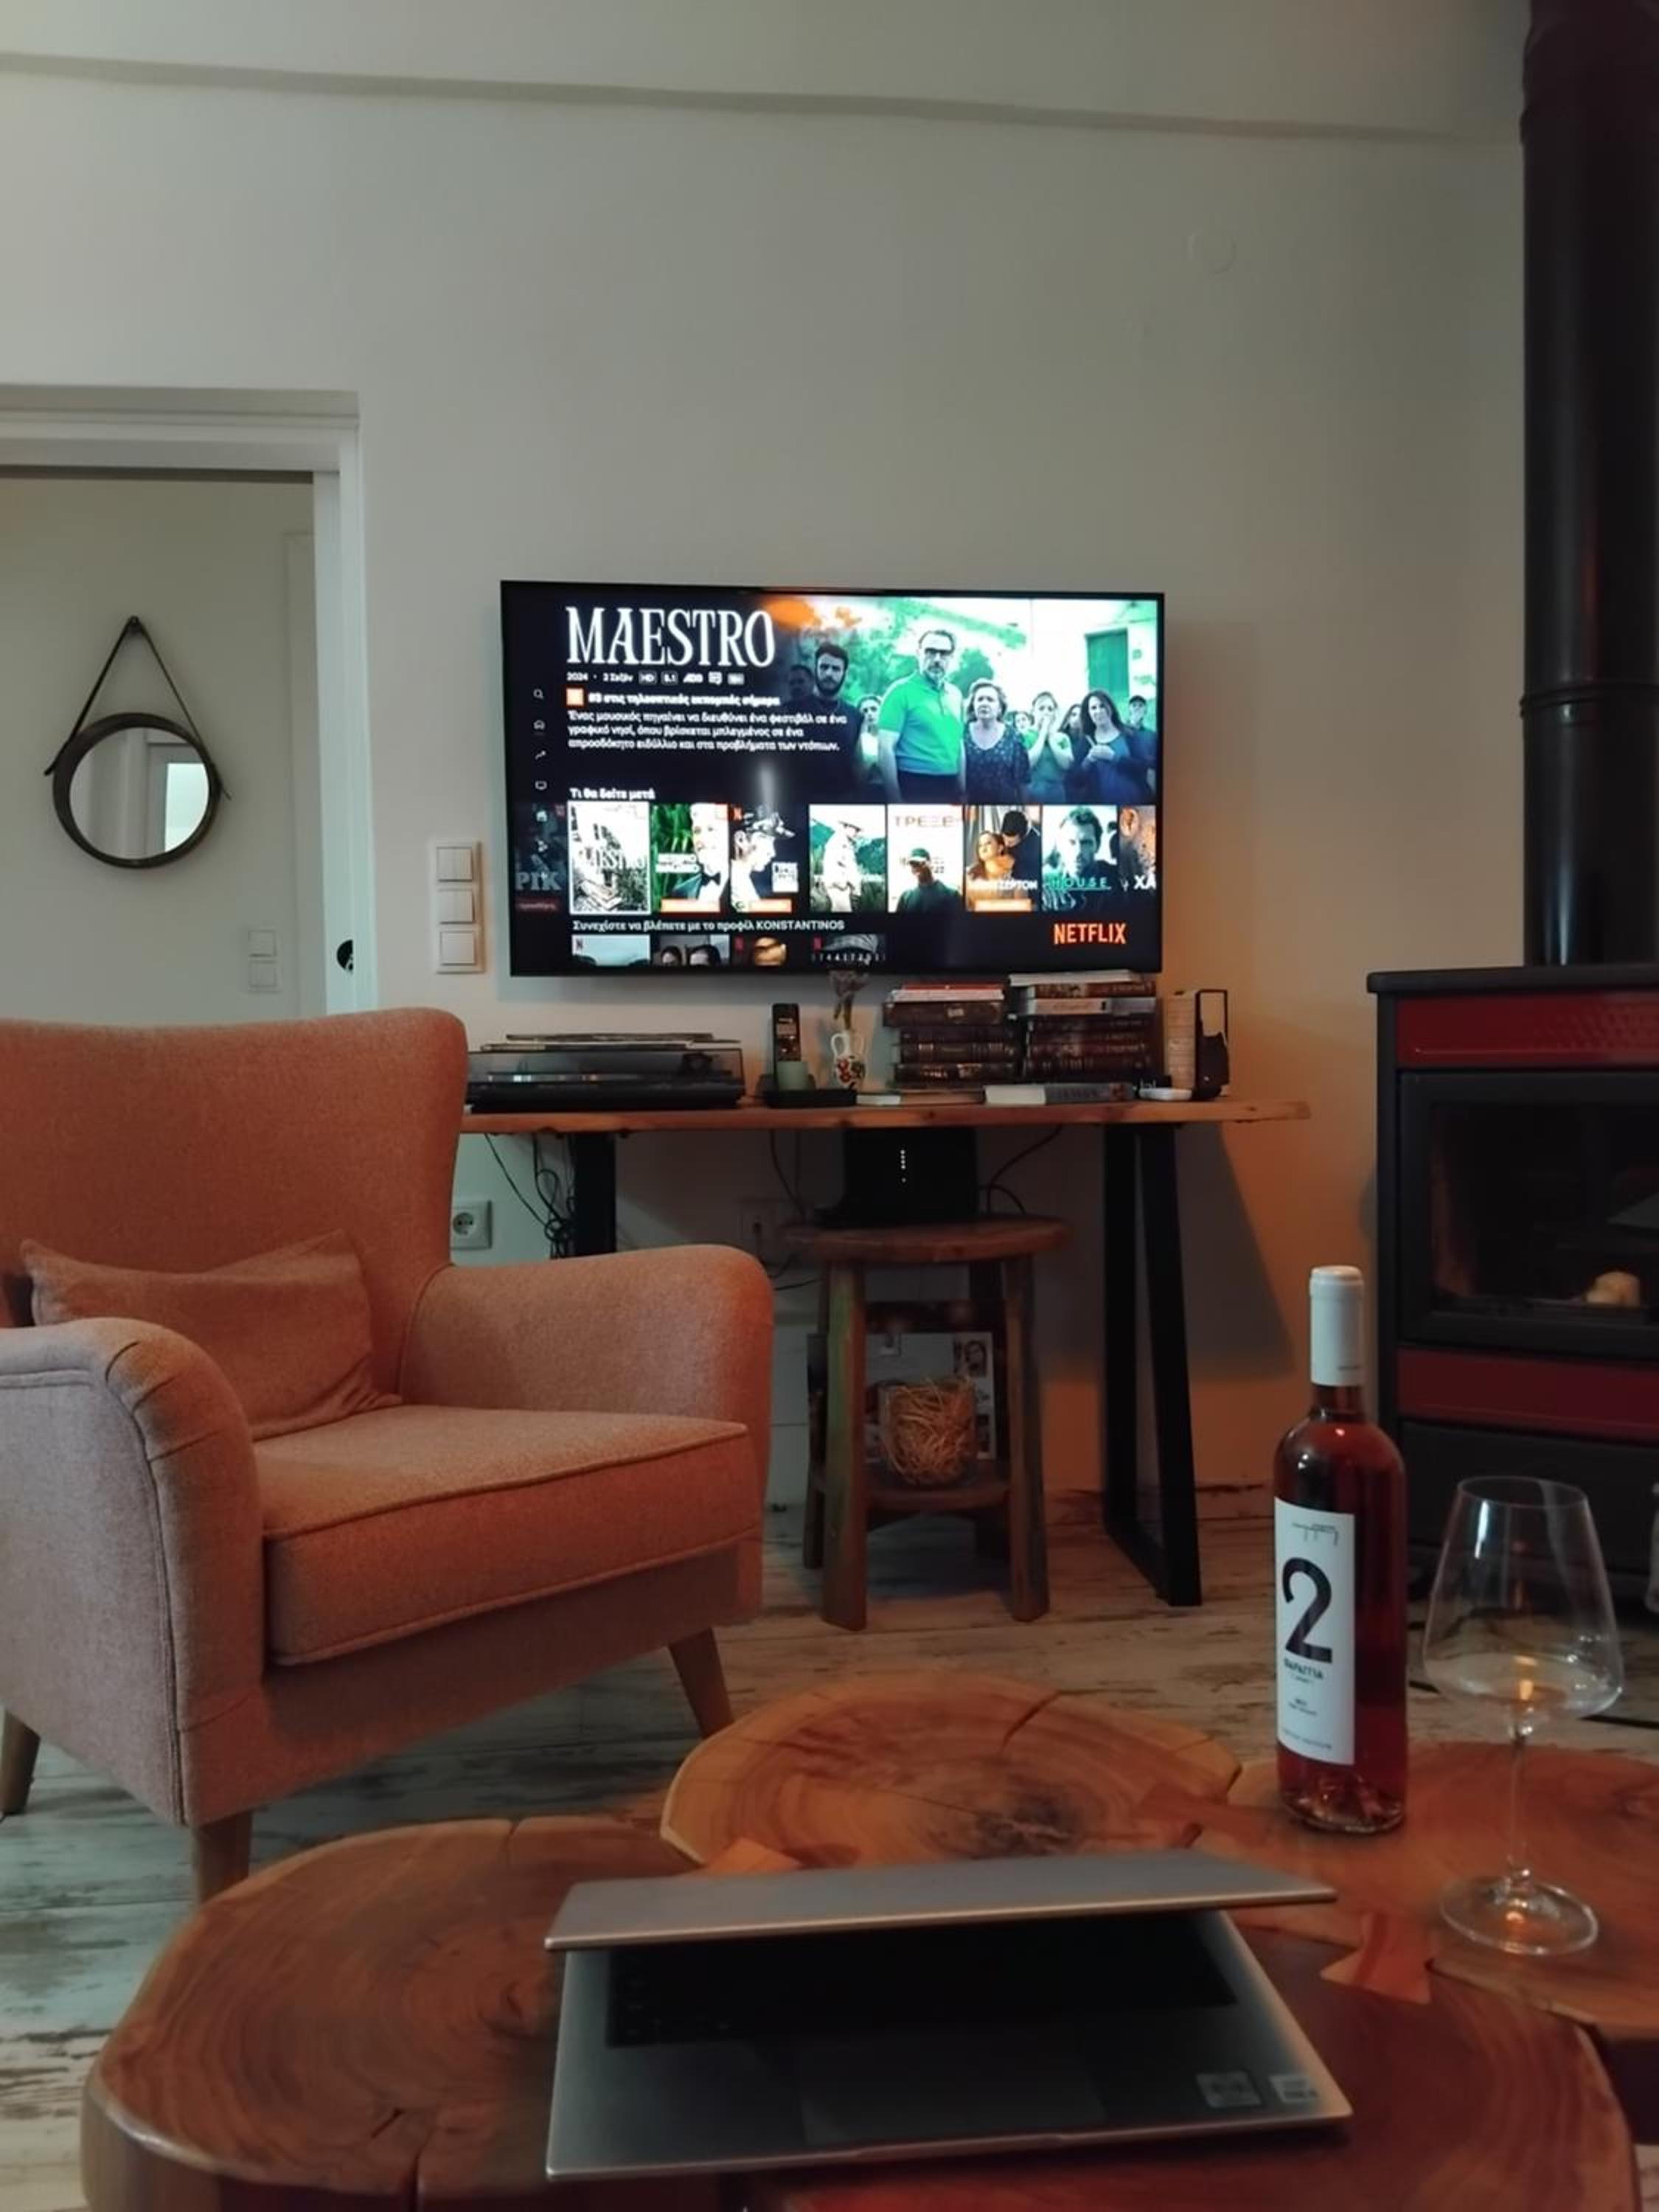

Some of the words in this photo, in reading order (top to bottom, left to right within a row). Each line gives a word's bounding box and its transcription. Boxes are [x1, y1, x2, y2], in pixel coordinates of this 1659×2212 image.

[566, 607, 775, 666] MAESTRO
[686, 713, 700, 723] να
[749, 712, 768, 723] ένα
[830, 713, 848, 725] ένα
[786, 726, 804, 737] ένα
[570, 787, 582, 799] Τι
[583, 787, 598, 799] θα
[629, 788, 655, 801] μετά
[1051, 877, 1108, 887] HOUSE
[573, 920, 626, 932] Συνεχίστε
[628, 922, 641, 931] να
[644, 920, 686, 932] βλέπετε
[688, 922, 700, 932] με
[703, 922, 715, 931] το
[717, 919, 754, 932] προφίλ
[756, 919, 845, 931] KONSTANTINOS
[1054, 922, 1127, 945] NETFLIX
[1281, 1557, 1333, 1664] 2
